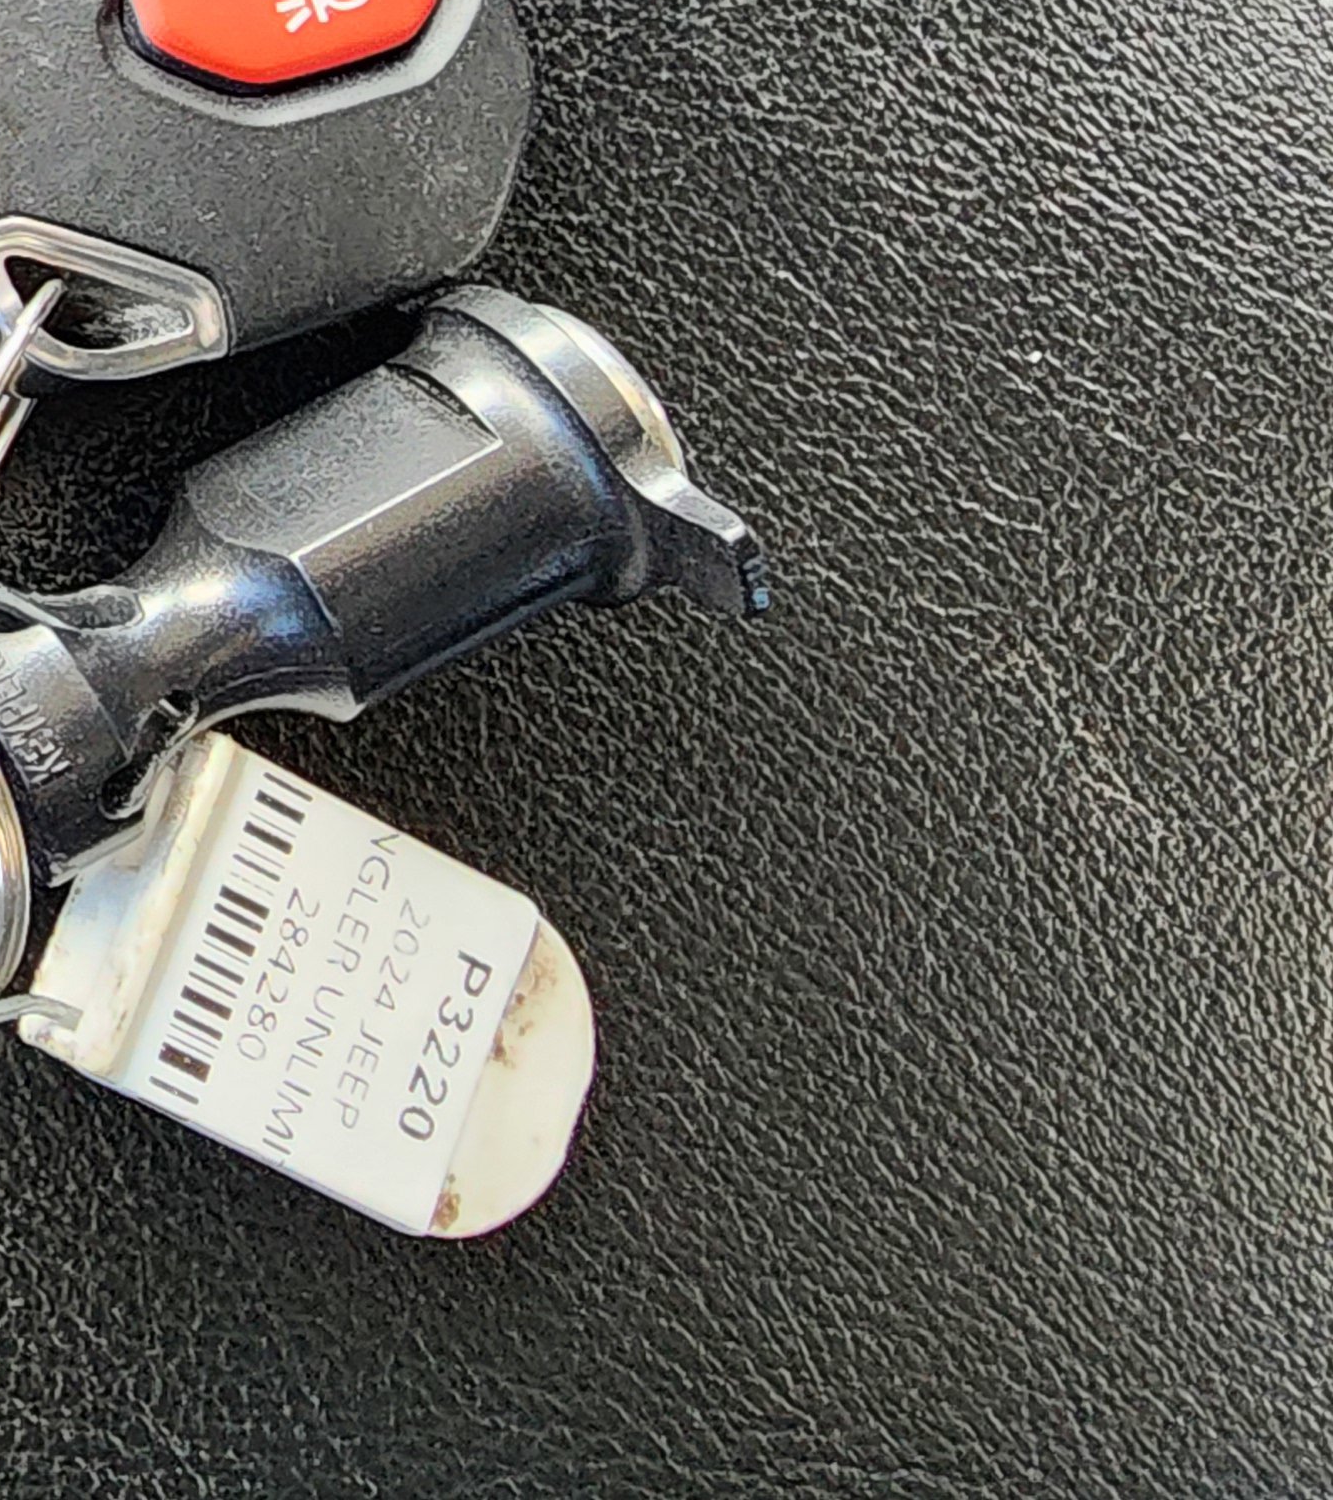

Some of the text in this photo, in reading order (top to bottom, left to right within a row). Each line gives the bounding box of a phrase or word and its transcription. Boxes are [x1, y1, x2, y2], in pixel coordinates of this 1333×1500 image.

[236, 887, 321, 1063] 284280
[334, 898, 431, 1130] 2024 JEEP
[398, 949, 493, 1142] P3220
[261, 985, 345, 1167] UNLIMI
